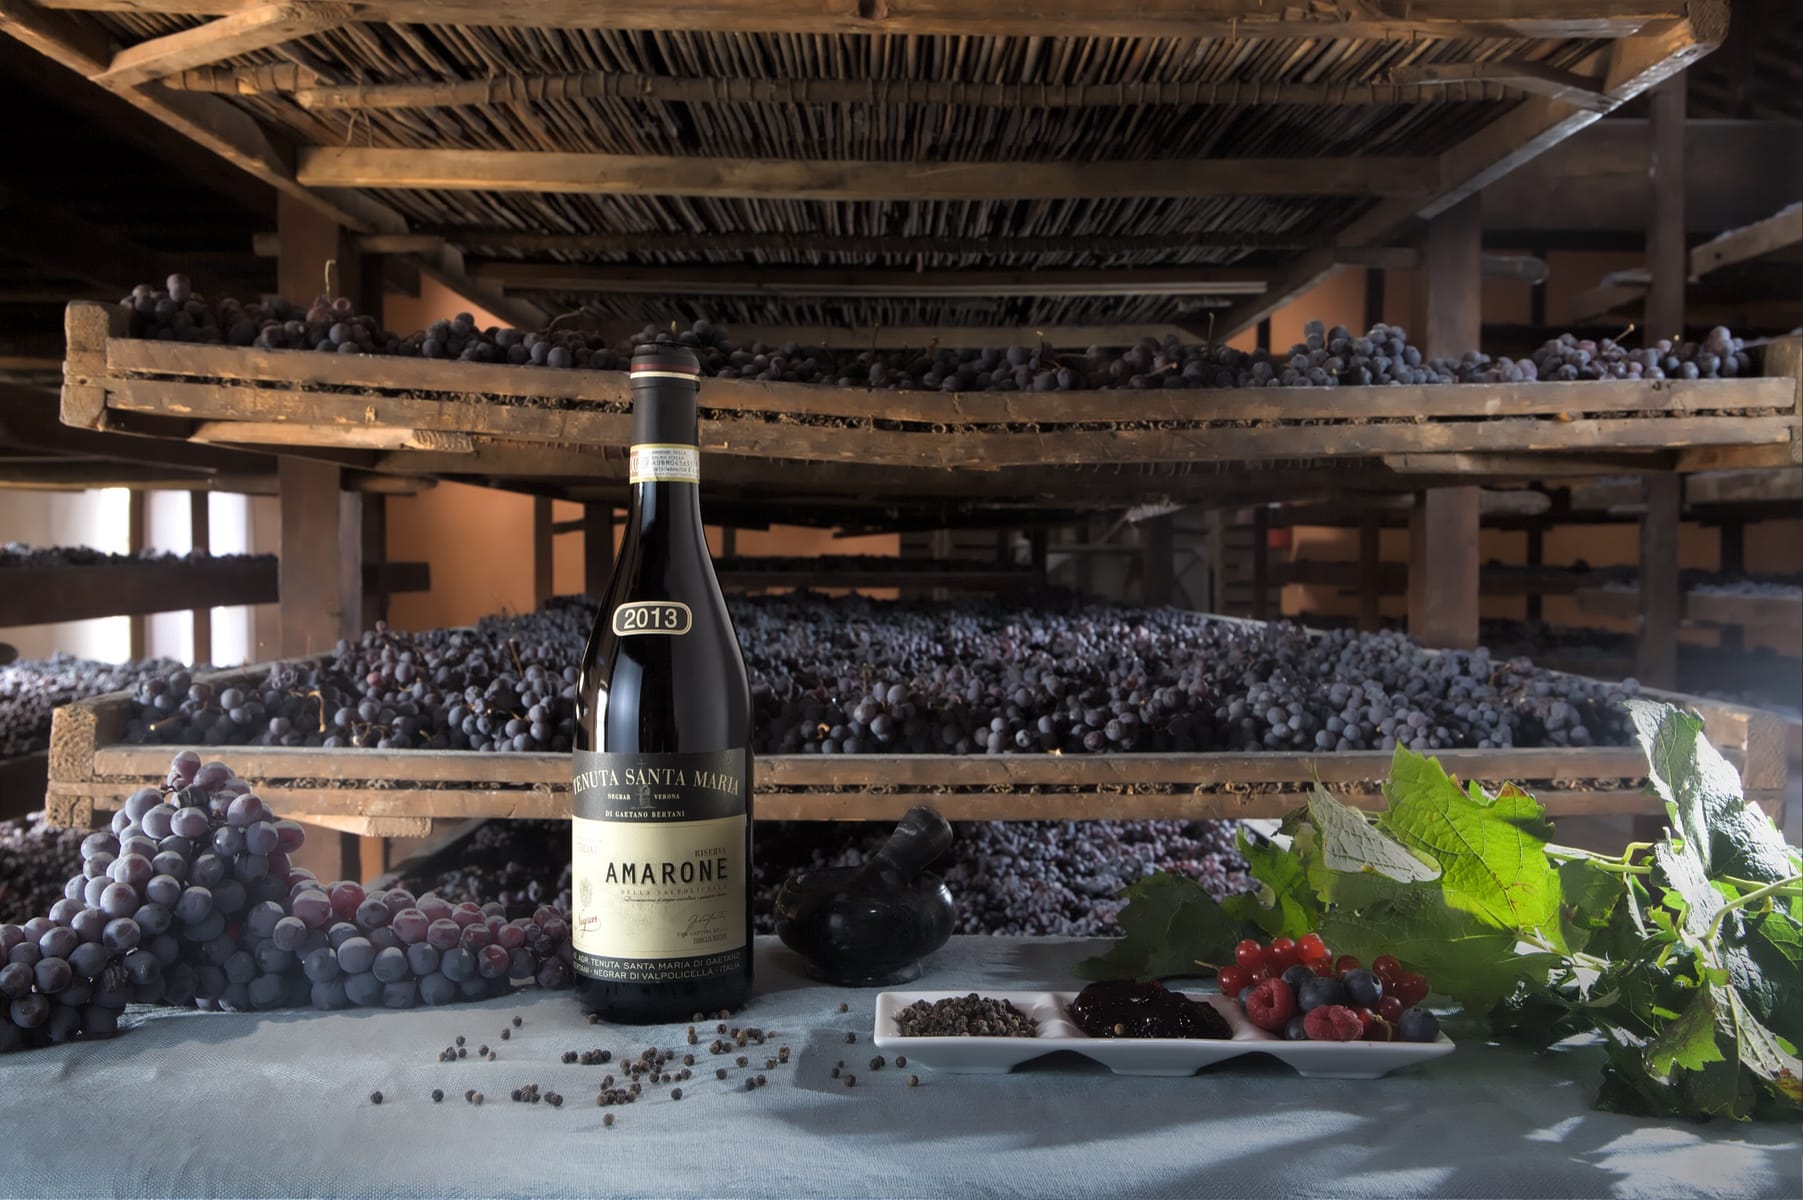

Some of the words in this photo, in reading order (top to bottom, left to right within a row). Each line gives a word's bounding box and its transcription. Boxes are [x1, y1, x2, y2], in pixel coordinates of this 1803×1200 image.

[624, 607, 677, 629] 2013
[573, 769, 619, 795] TENUTA
[625, 768, 686, 786] SANTA
[693, 769, 738, 796] MARIA
[615, 810, 648, 818] GAETANO
[651, 810, 685, 818] BERTANI
[694, 847, 726, 857] RISERVA
[605, 858, 728, 884] AMARONE
[591, 958, 620, 969] TENUTA
[623, 961, 656, 970] SANTA
[658, 961, 690, 970] MARIA
[706, 951, 741, 966] GAETANO
[594, 969, 627, 979] NEGRAR
[629, 970, 640, 980] DI
[642, 968, 713, 980] VALPOLICELLA
[719, 962, 740, 974] ITALIA
